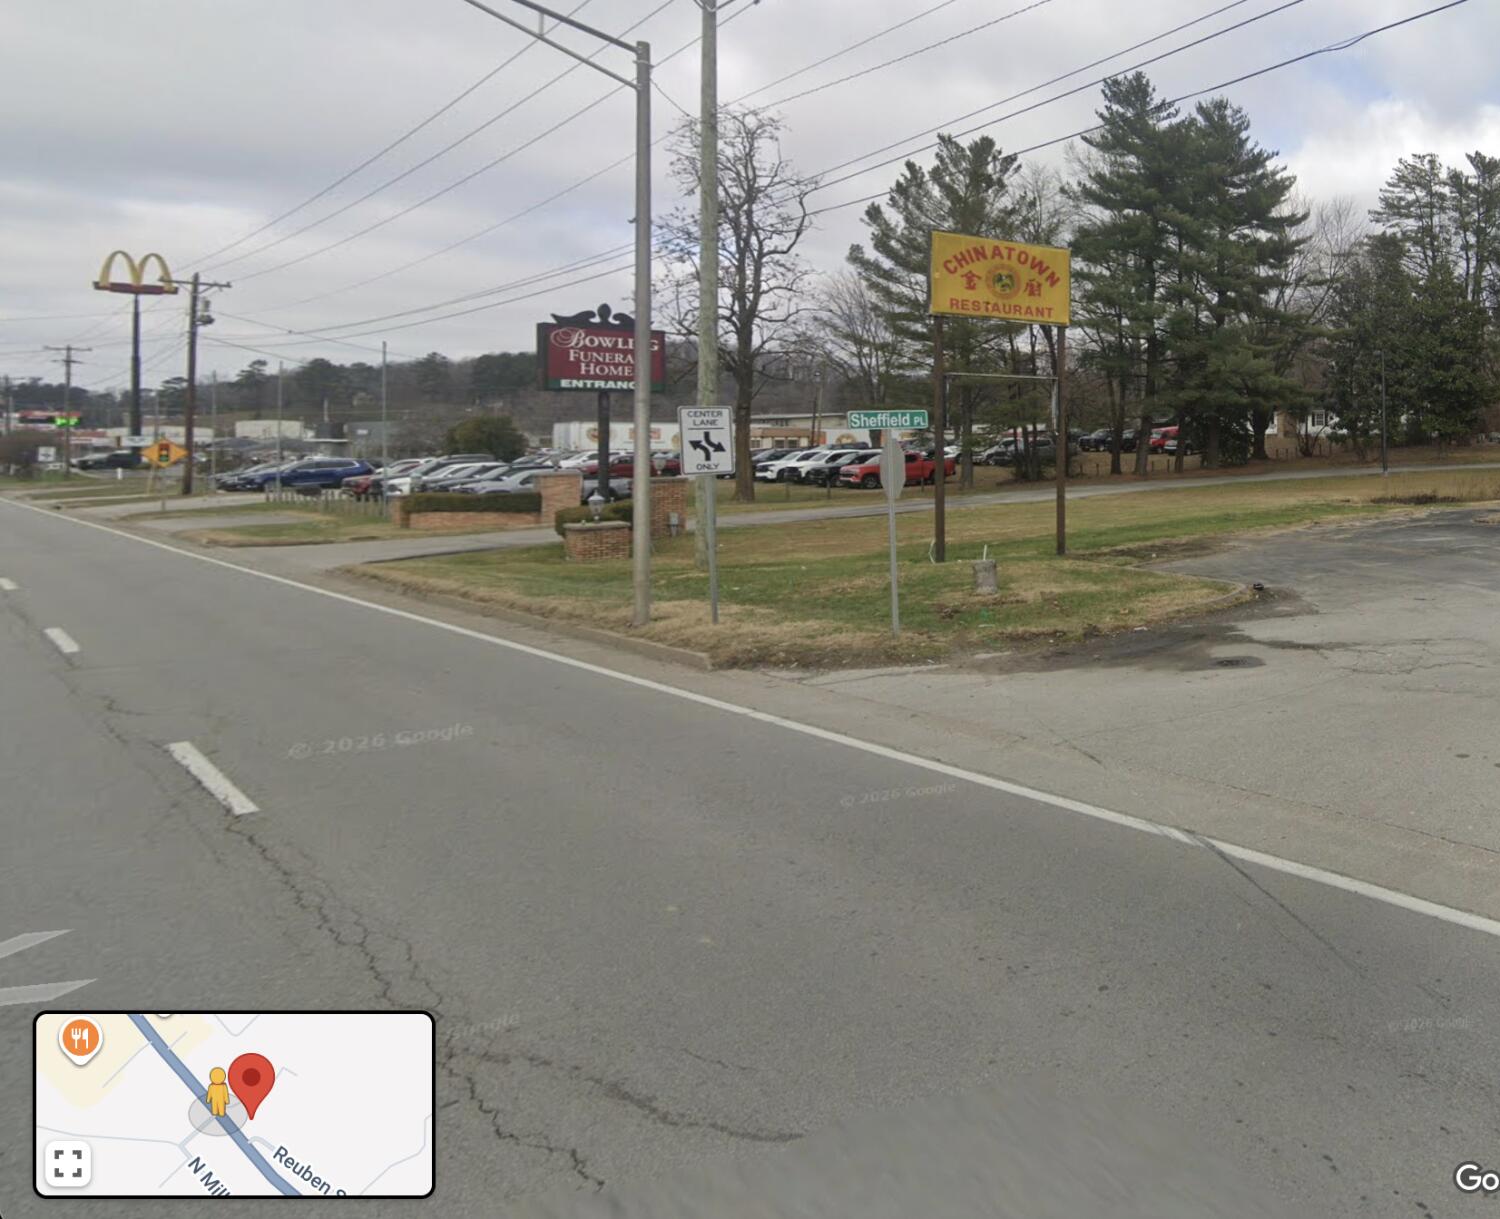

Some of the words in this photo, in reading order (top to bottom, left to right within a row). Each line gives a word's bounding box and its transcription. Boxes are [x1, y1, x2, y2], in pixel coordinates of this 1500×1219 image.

[943, 245, 1060, 288] CHINATOWN
[949, 298, 1054, 318] RESTAURANT
[550, 327, 659, 351] BOWLIG
[569, 349, 635, 364] FUNERA
[580, 362, 633, 376] HOME
[560, 379, 636, 389] ENTRANC
[687, 410, 723, 418] CENTER
[850, 413, 910, 427] Sheffield
[914, 417, 927, 426] PL
[695, 463, 720, 471] ONLY
